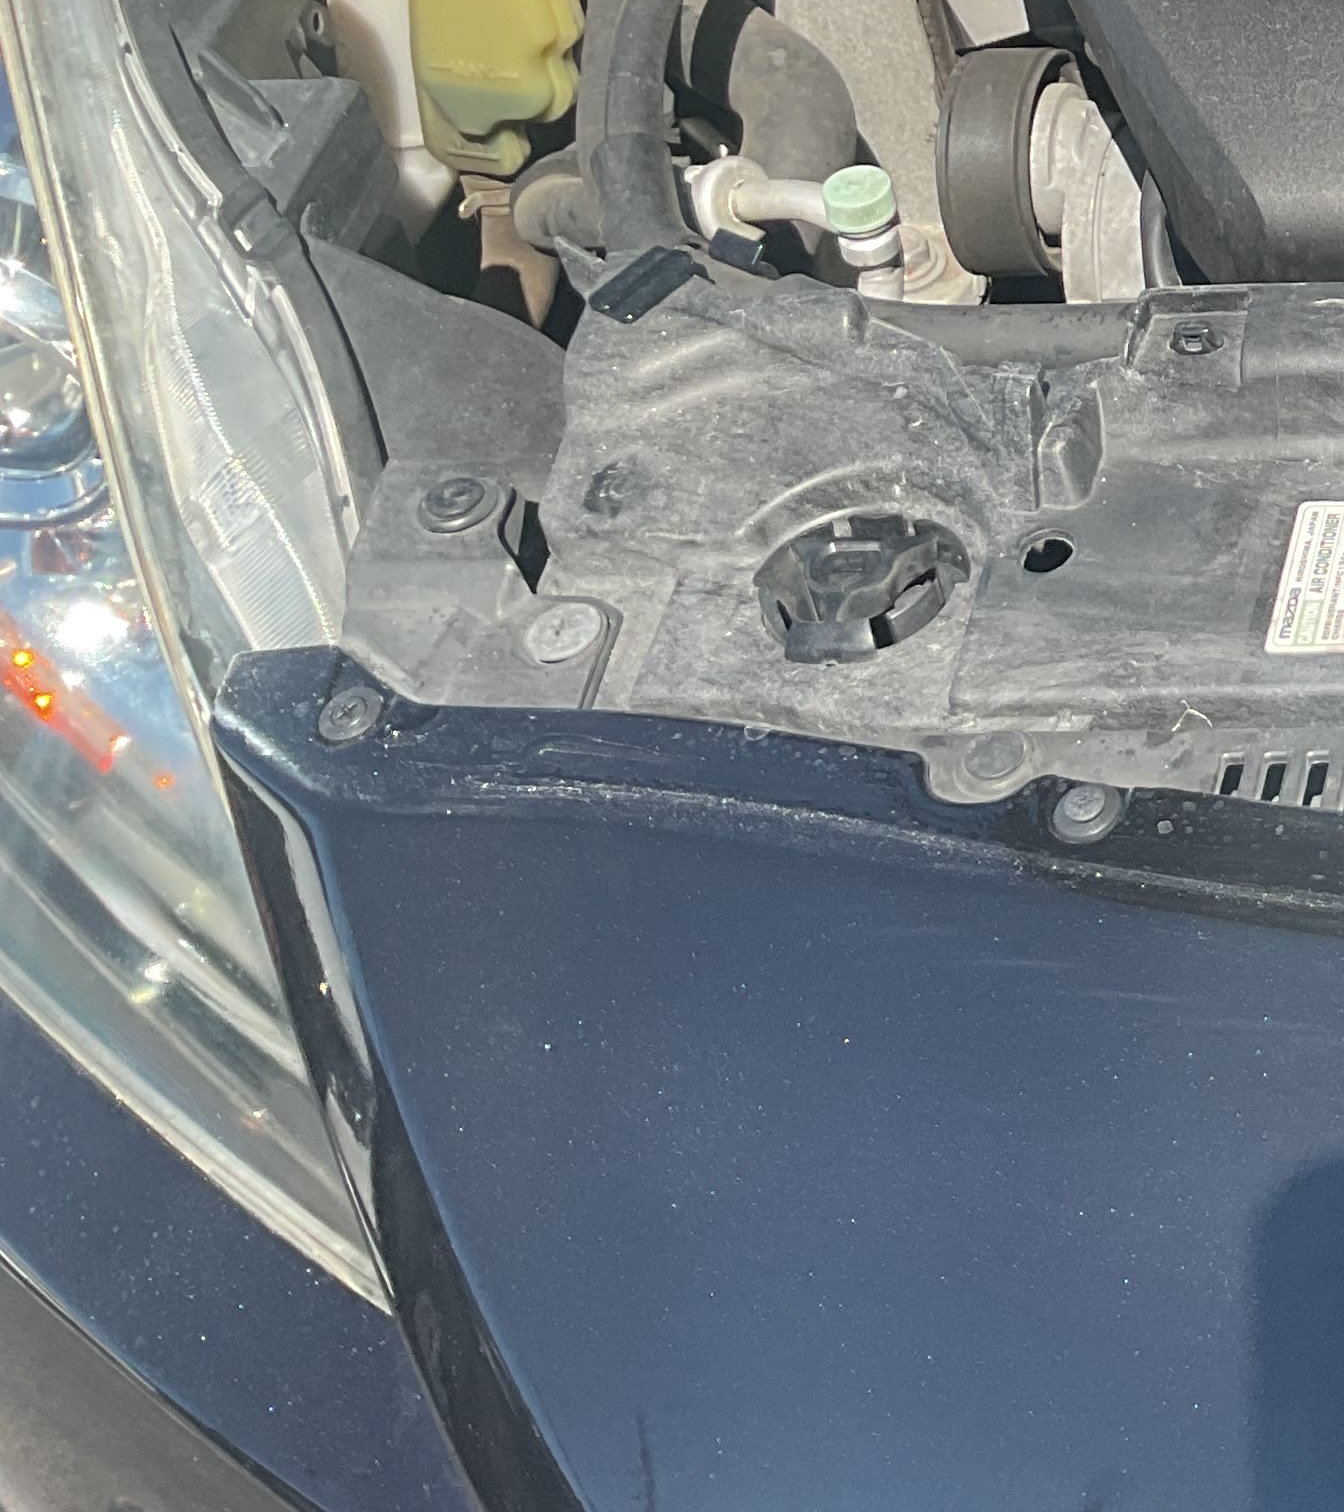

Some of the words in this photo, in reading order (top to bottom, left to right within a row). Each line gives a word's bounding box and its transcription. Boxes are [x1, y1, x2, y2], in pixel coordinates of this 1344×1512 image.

[1313, 513, 1340, 574] CONDITIONER
[1279, 587, 1301, 638] mazda
[1306, 511, 1318, 535] JAPAN
[1309, 577, 1325, 593] AIR
[1296, 602, 1320, 642] CAUTION
